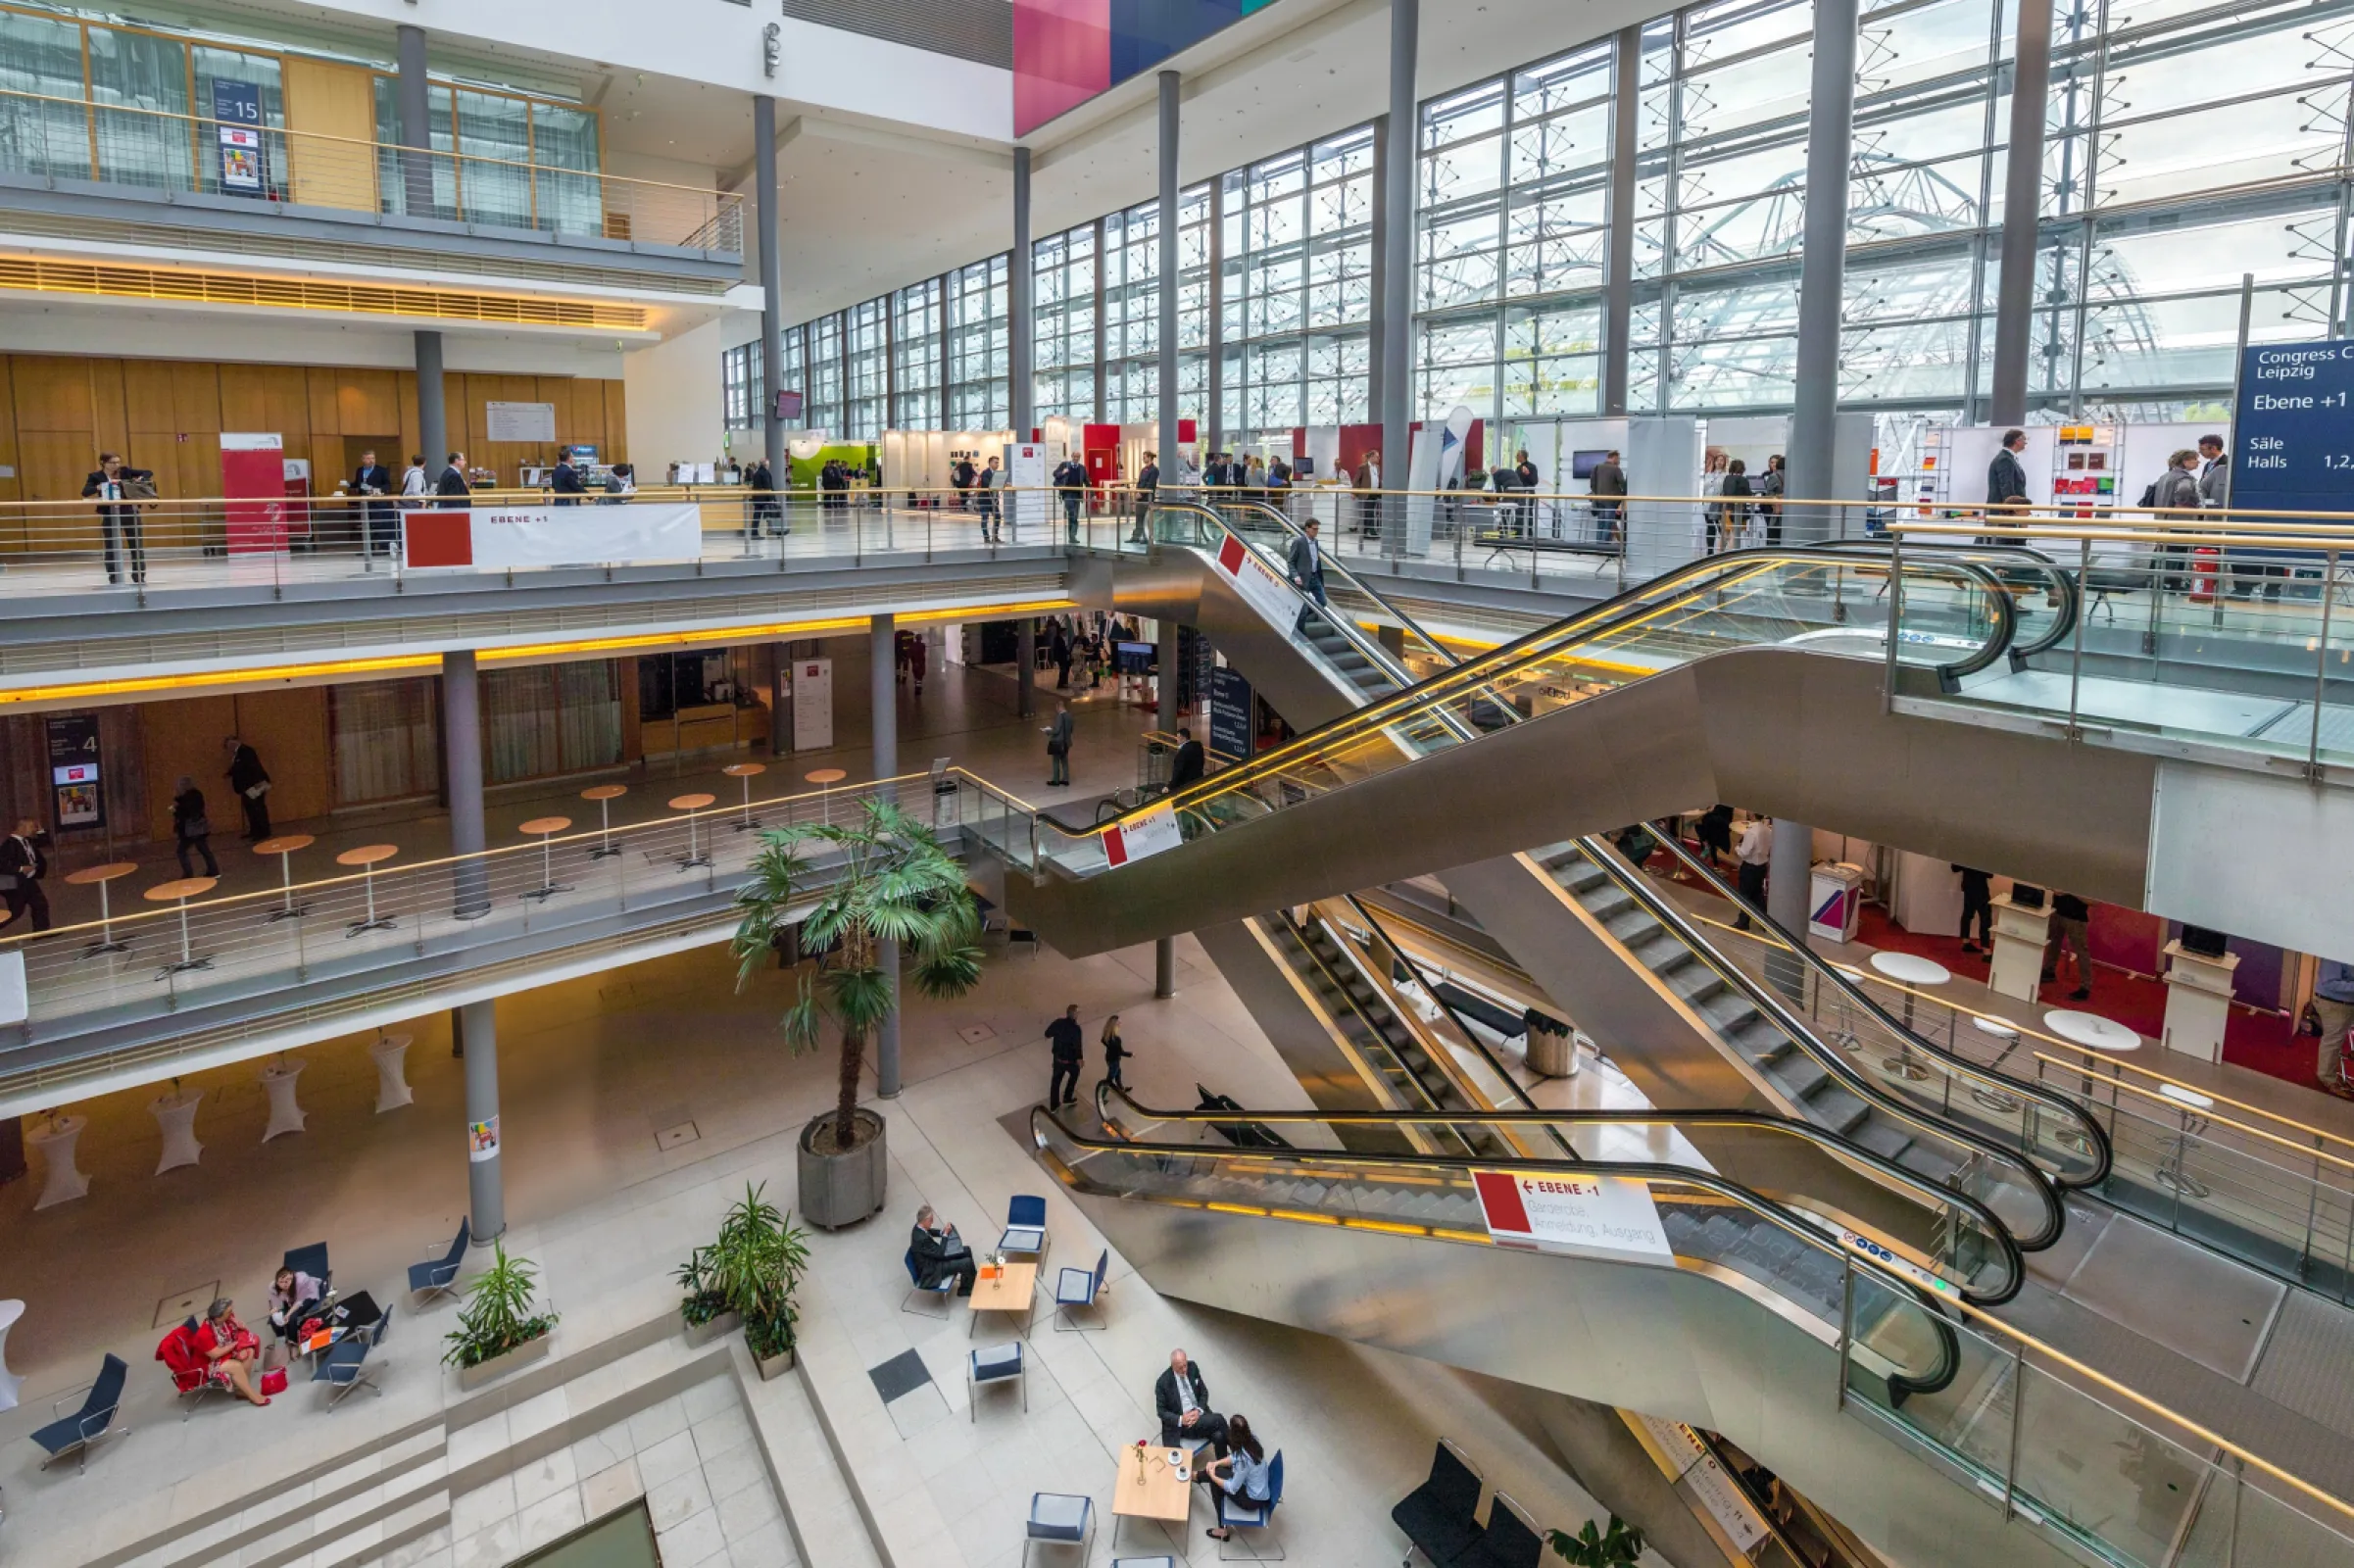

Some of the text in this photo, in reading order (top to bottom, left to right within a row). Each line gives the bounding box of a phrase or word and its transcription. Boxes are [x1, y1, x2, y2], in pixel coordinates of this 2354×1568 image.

[235, 101, 258, 119] 15
[2258, 349, 2336, 366] Congress
[2257, 364, 2315, 380] Leipzig
[2254, 391, 2346, 410] Ebene +1
[2249, 436, 2284, 450] Säle
[2247, 455, 2287, 468] Halls
[82, 736, 97, 753] 4
[1538, 1180, 1600, 1197] EBENE -1
[1527, 1200, 1591, 1219] Garderobe,
[1534, 1217, 1656, 1244] Anmeldung, Ausgang
[1676, 1421, 1705, 1453] ENE
